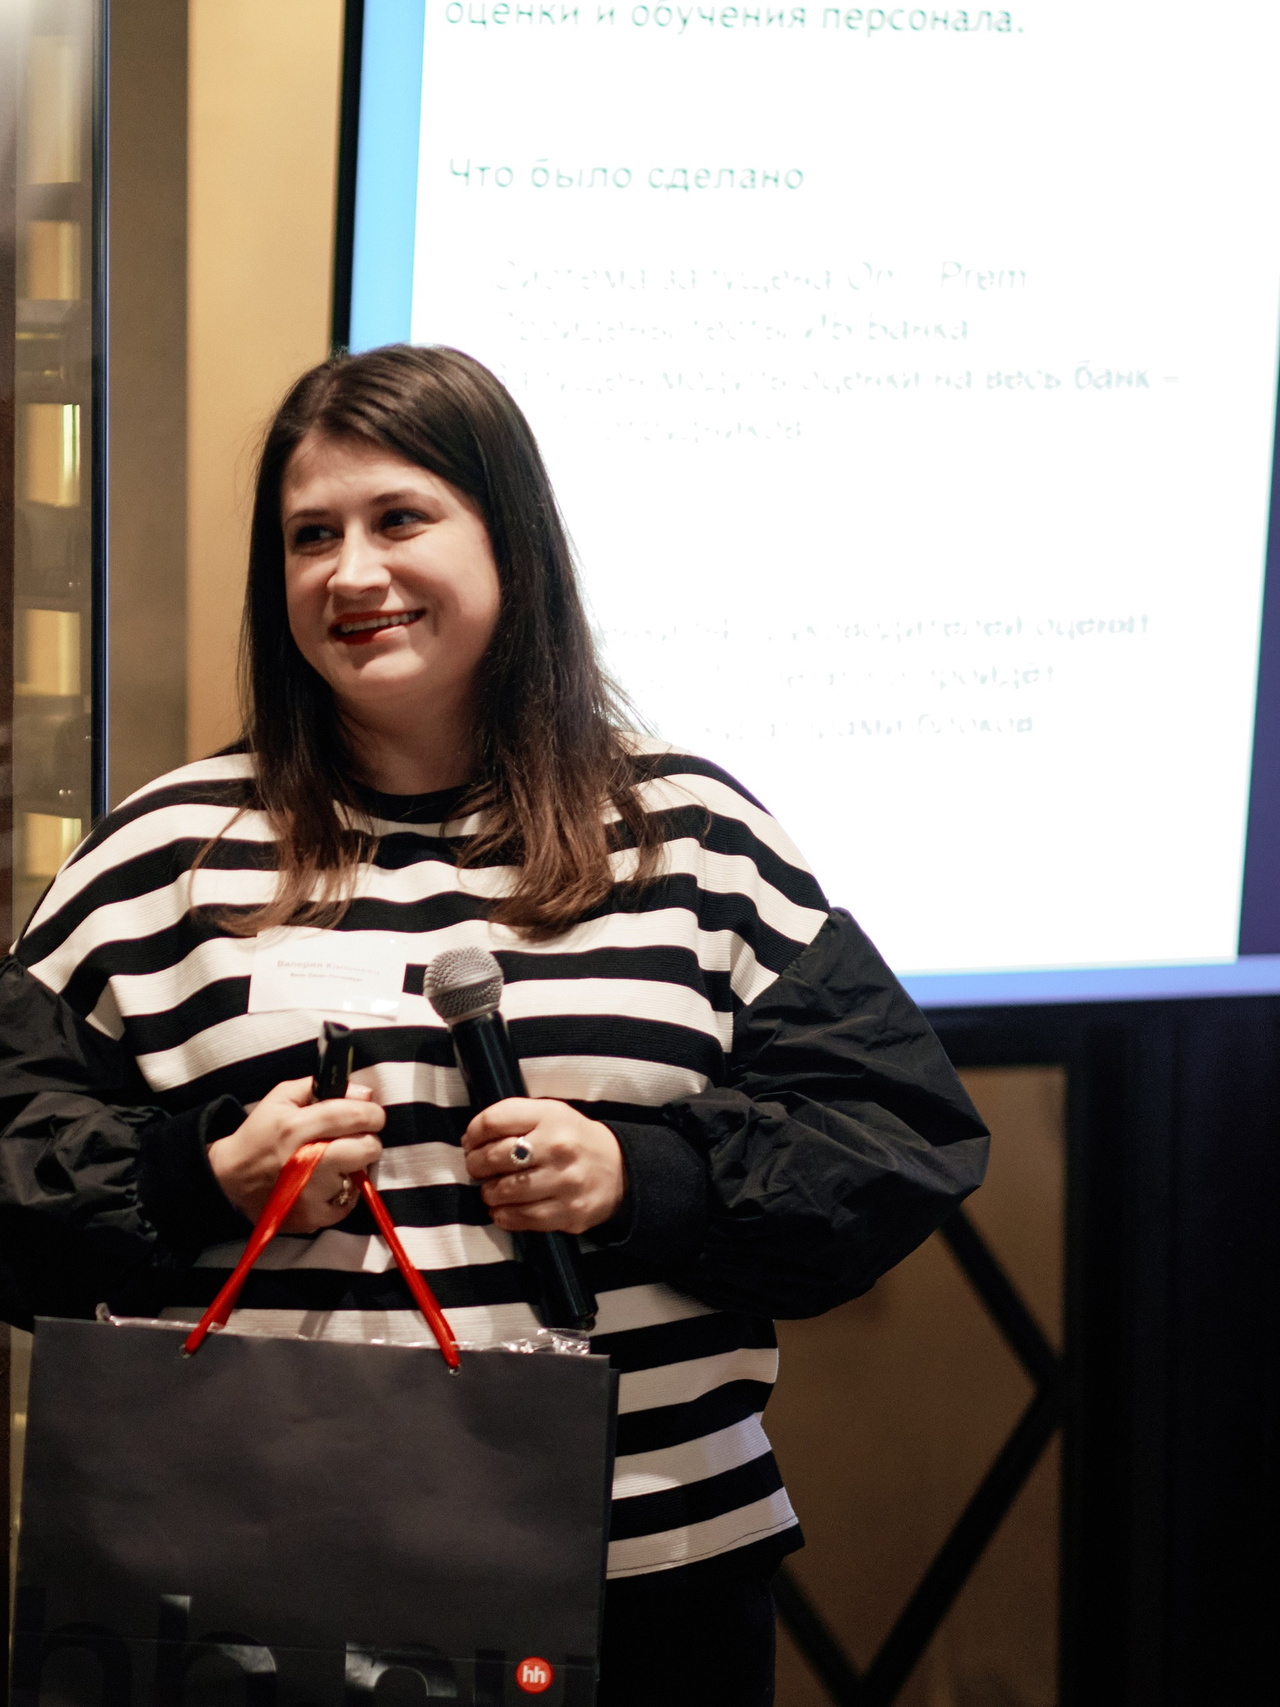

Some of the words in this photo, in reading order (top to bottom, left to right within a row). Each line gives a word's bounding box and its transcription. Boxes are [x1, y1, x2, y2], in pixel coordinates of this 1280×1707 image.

[444, 0, 581, 30] оценки
[596, 2, 616, 25] и
[630, 0, 808, 36] обучения
[822, 3, 1025, 38] персонала.
[449, 158, 515, 190] Что
[530, 157, 634, 190] было
[647, 164, 805, 194] сделано
[1071, 358, 1152, 392] банк
[277, 959, 323, 970] Валерия
[523, 1665, 546, 1684] hh
